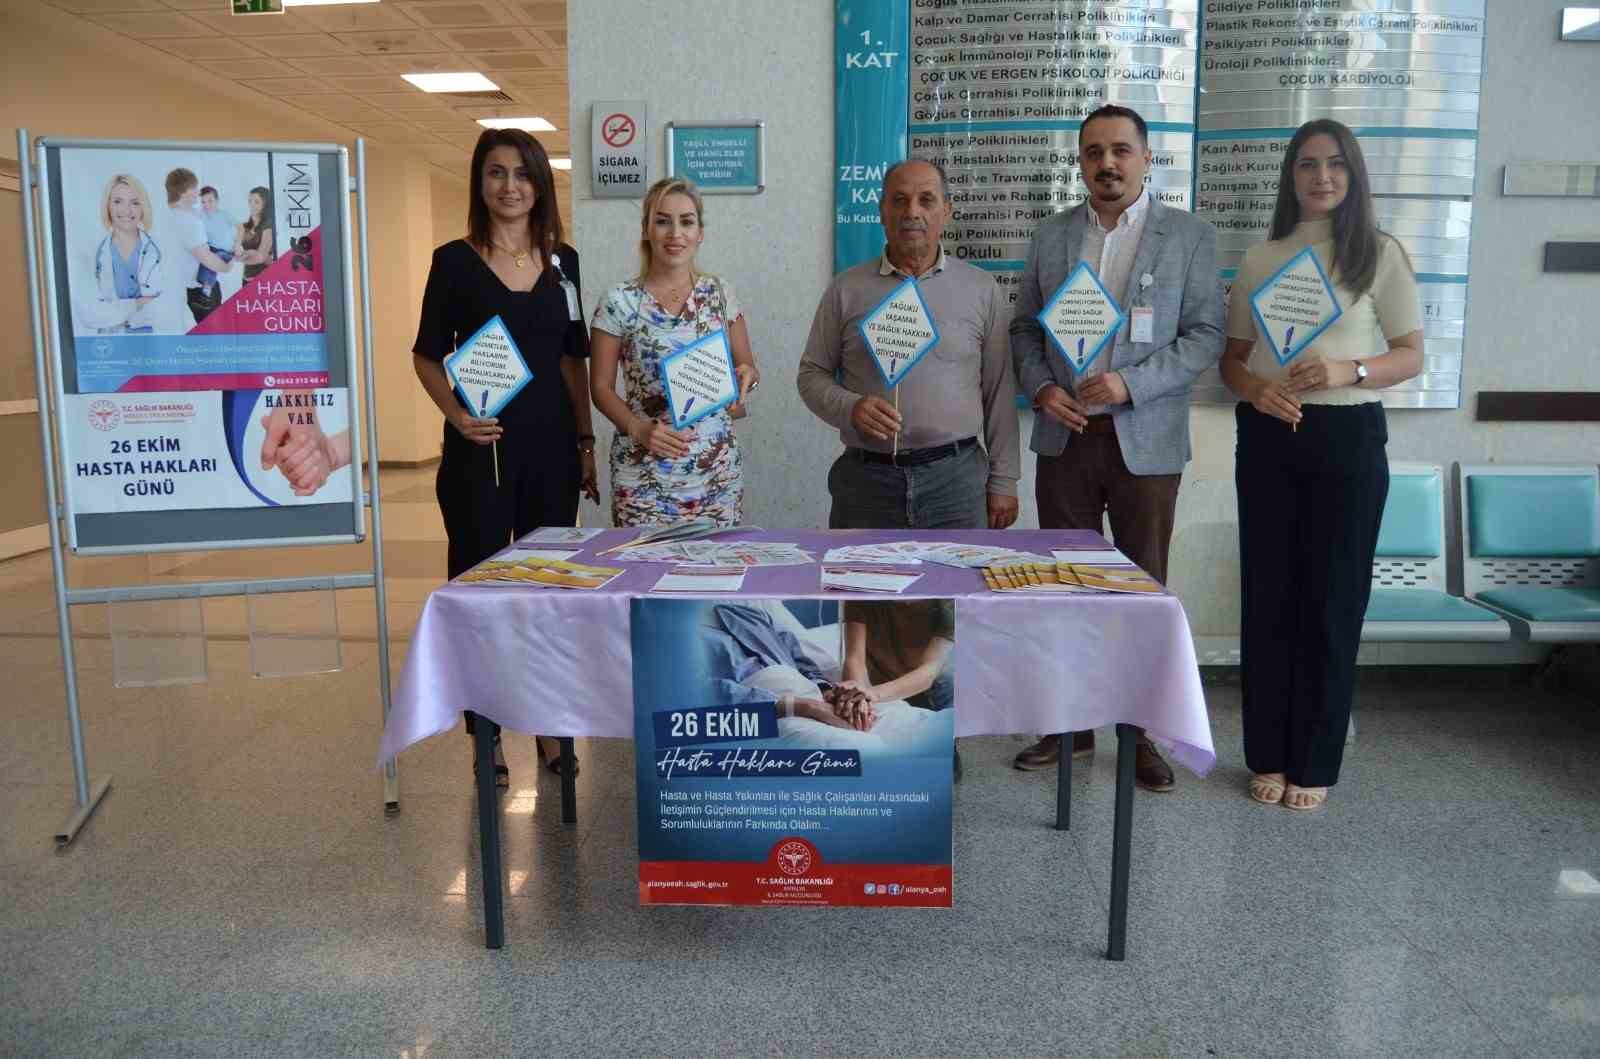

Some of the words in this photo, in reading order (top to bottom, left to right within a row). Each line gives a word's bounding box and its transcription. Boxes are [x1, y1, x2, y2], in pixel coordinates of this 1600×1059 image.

[1207, 0, 1253, 13] Cildiye
[915, 16, 944, 28] Kalp
[947, 16, 962, 25] ve
[967, 13, 1009, 24] Damar
[1013, 11, 1072, 23] Cerrahisi
[1078, 10, 1155, 23] Poliklinikleri
[1206, 19, 1248, 31] Plastik
[1305, 18, 1321, 27] ve
[914, 35, 956, 47] Çocuk
[960, 32, 1004, 45] Sağlığı
[1008, 32, 1024, 41] ve
[1029, 31, 1100, 42] Hastalıkları
[1205, 38, 1267, 51] Psikiyatri
[1272, 35, 1352, 48] Poliklinikleri
[846, 52, 898, 69] KAT
[914, 53, 955, 65] Çocuk
[1037, 48, 1118, 60] Poliklinikleri
[1205, 59, 1249, 71] Üroloji
[920, 71, 967, 84] ÇOCUK
[970, 70, 988, 80] VE
[992, 69, 1038, 80] ERGEN
[1279, 74, 1326, 86] ÇOCUK
[914, 91, 955, 103] Çocuk
[959, 88, 1018, 100] Cerrahisi
[1022, 86, 1103, 98] Poliklinikleri
[961, 106, 1019, 118] Cerrahisi
[913, 137, 964, 149] Dahiliye
[969, 134, 1049, 146] Poliklinikleri
[1202, 144, 1228, 155] Kan
[1231, 143, 1265, 154] Alma
[599, 155, 639, 170] SİGARA
[954, 154, 1027, 166] Hastalıkları
[1031, 154, 1048, 164] ve
[840, 162, 888, 181] ZEMİ
[1202, 162, 1242, 175] Sağlık
[599, 172, 641, 188] İÇİLMEZ
[974, 175, 988, 184] ve
[992, 173, 1072, 185] Travmatoloji
[1200, 181, 1257, 193] Danışma
[282, 163, 311, 228] EKİM
[992, 193, 1006, 202] ve
[1200, 199, 1245, 212] Engelli
[837, 214, 851, 224] Bu
[952, 209, 1011, 222] Cerrahisi
[290, 235, 313, 272] 26
[957, 246, 1002, 260] Okulu
[257, 280, 321, 296] HASTA
[235, 299, 321, 314] HAKLARI
[264, 314, 322, 332] GÜNÜ
[265, 393, 335, 409] HAKKINIZ
[287, 412, 314, 425] VAR
[111, 439, 131, 454] 26
[138, 436, 181, 453] EKİM
[76, 460, 133, 477] HASTA
[140, 457, 217, 474] HAKLARI
[124, 478, 175, 497] GÜNÜ
[670, 711, 699, 738] 26
[707, 706, 760, 738] EKİM
[657, 746, 713, 780] Hasta
[800, 750, 858, 776] Günü
[660, 790, 689, 802] Hasta
[690, 793, 702, 801] ve
[704, 790, 732, 802] Hasta
[734, 790, 777, 802] Yakınları
[778, 791, 790, 802] ile
[791, 790, 823, 804] Sağlık
[824, 790, 877, 805] Çalışanları
[878, 791, 929, 803] Arasındaki
[660, 804, 703, 818] İletişimin
[704, 804, 777, 818] Güçlendirilmesi
[779, 805, 797, 818] için
[799, 805, 827, 817] Hasta
[828, 805, 878, 817] Haklarının
[880, 808, 892, 817] ve
[660, 818, 743, 830] Sorumluluklarının
[745, 818, 788, 830] Farkında
[755, 876, 769, 886] T.C.
[769, 876, 795, 886] SAĞLIK
[795, 876, 834, 886] BAKANLIĞI
